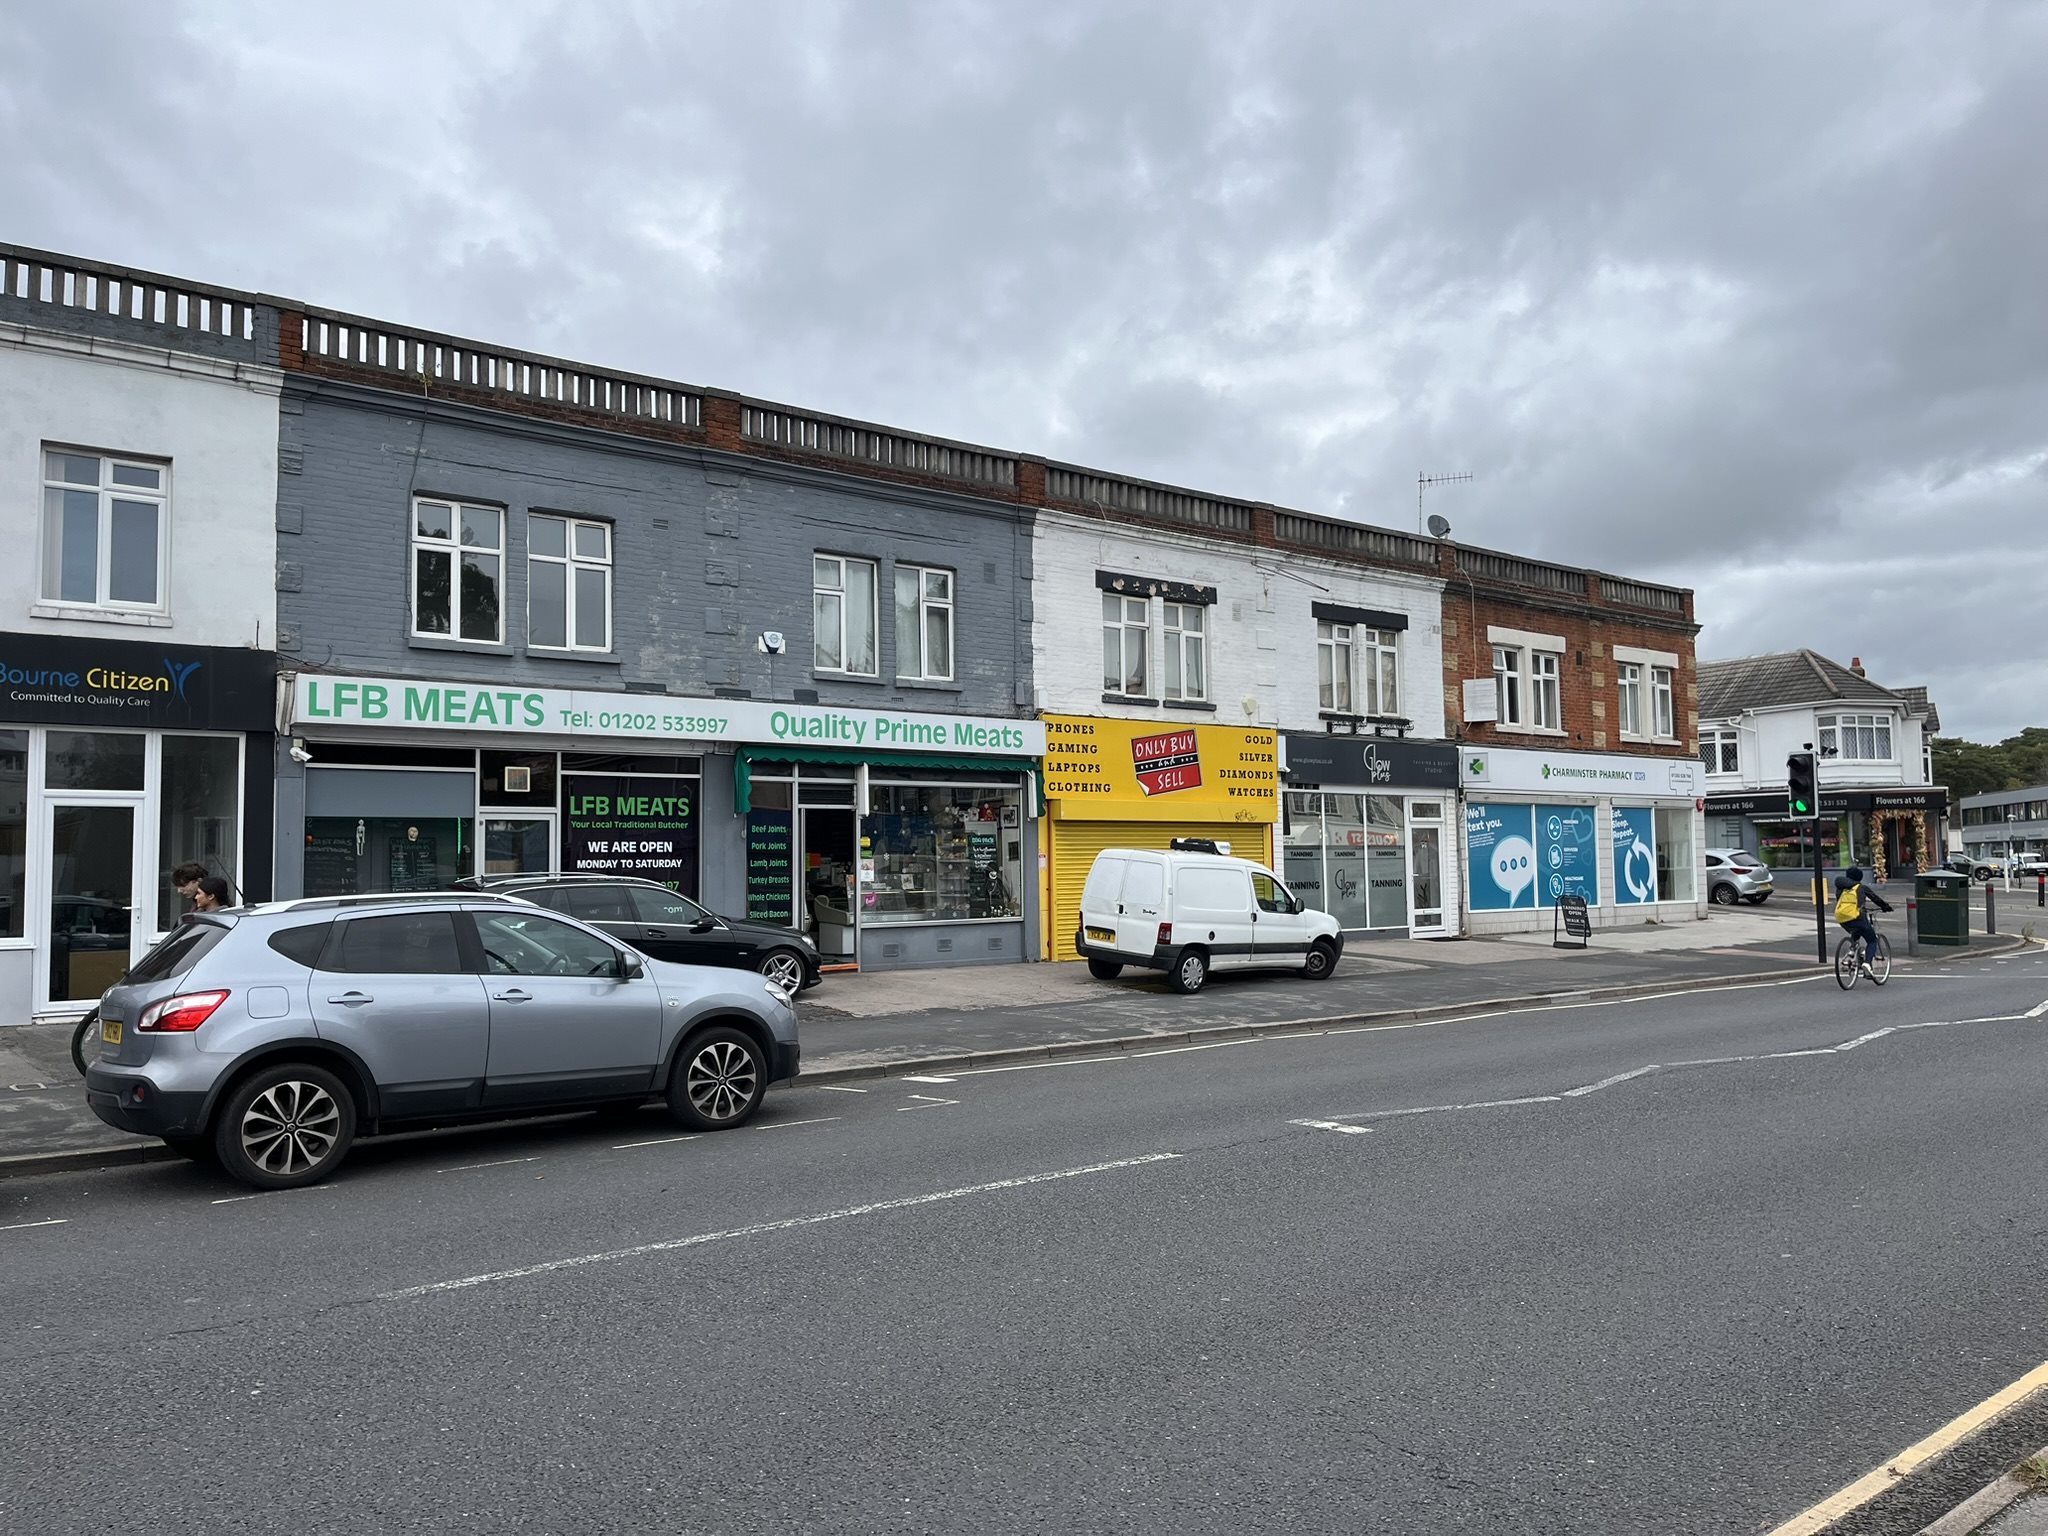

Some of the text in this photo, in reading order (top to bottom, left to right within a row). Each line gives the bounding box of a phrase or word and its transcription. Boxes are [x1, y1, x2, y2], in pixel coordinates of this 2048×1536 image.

[86, 668, 169, 692] Citizen
[10, 690, 150, 708] Committed to Quality Care
[308, 682, 544, 726] LFB MEATS
[560, 710, 728, 734] Tel: 01202 533997
[770, 711, 1024, 749] Quality Prime Meats
[1048, 723, 1094, 734] PHONES
[1245, 735, 1272, 744] GOLD
[1048, 742, 1098, 754] GAMING
[1136, 734, 1194, 758] ONLY BUY
[1240, 752, 1273, 762] SILVER
[1363, 744, 1390, 771] Glow
[1048, 762, 1100, 772] LAPTOPS
[1158, 770, 1184, 790] SELL
[1220, 770, 1274, 780] DIAMONDS
[1371, 767, 1391, 784] plus
[1552, 768, 1597, 778] CHARMINSTER
[1599, 770, 1632, 780] PHARMACY
[1048, 782, 1111, 792] CLOTHING
[1228, 788, 1274, 797] WATCHES
[570, 796, 690, 816] LFB MEATS
[1876, 796, 1903, 804] Flowers
[1468, 806, 1486, 819] We'll
[571, 821, 590, 829] Your
[614, 821, 656, 829] Traditional
[1468, 819, 1503, 832] text you.
[588, 841, 673, 852] WE ARE OPEN
[576, 859, 682, 868] MONDAY TO SATURDAY
[1286, 882, 1320, 890] TANNING
[1371, 880, 1402, 888] TANNING
